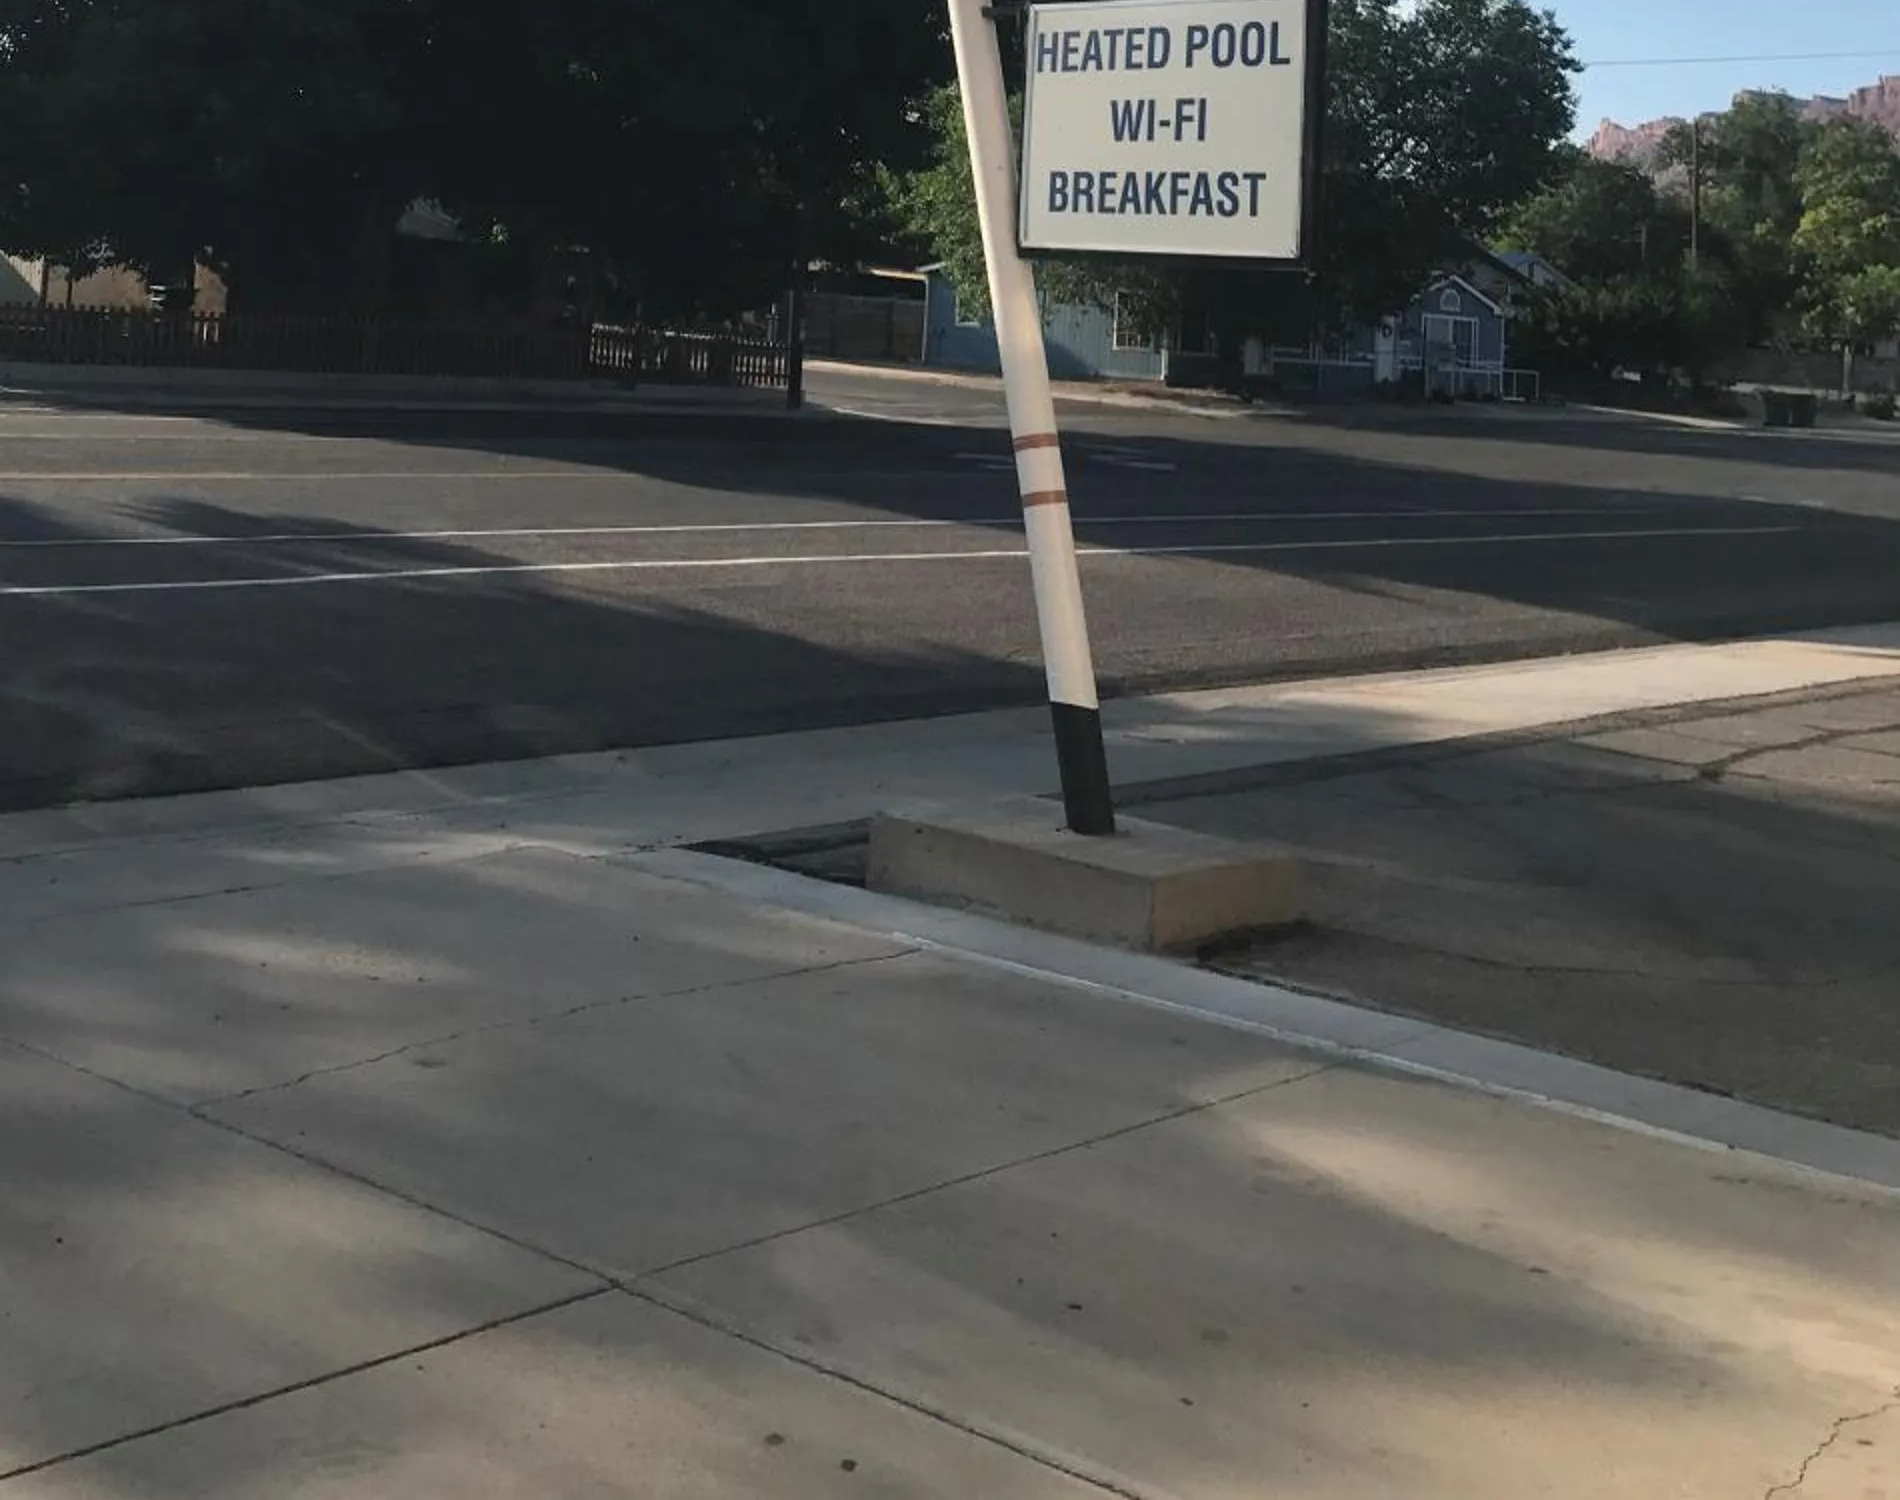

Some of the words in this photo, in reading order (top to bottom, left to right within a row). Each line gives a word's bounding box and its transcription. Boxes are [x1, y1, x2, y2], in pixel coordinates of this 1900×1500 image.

[1037, 26, 1171, 73] HEATED
[1185, 21, 1290, 68] POOL
[1110, 97, 1207, 142] WI-FI
[1048, 171, 1267, 217] BREAKFAST
